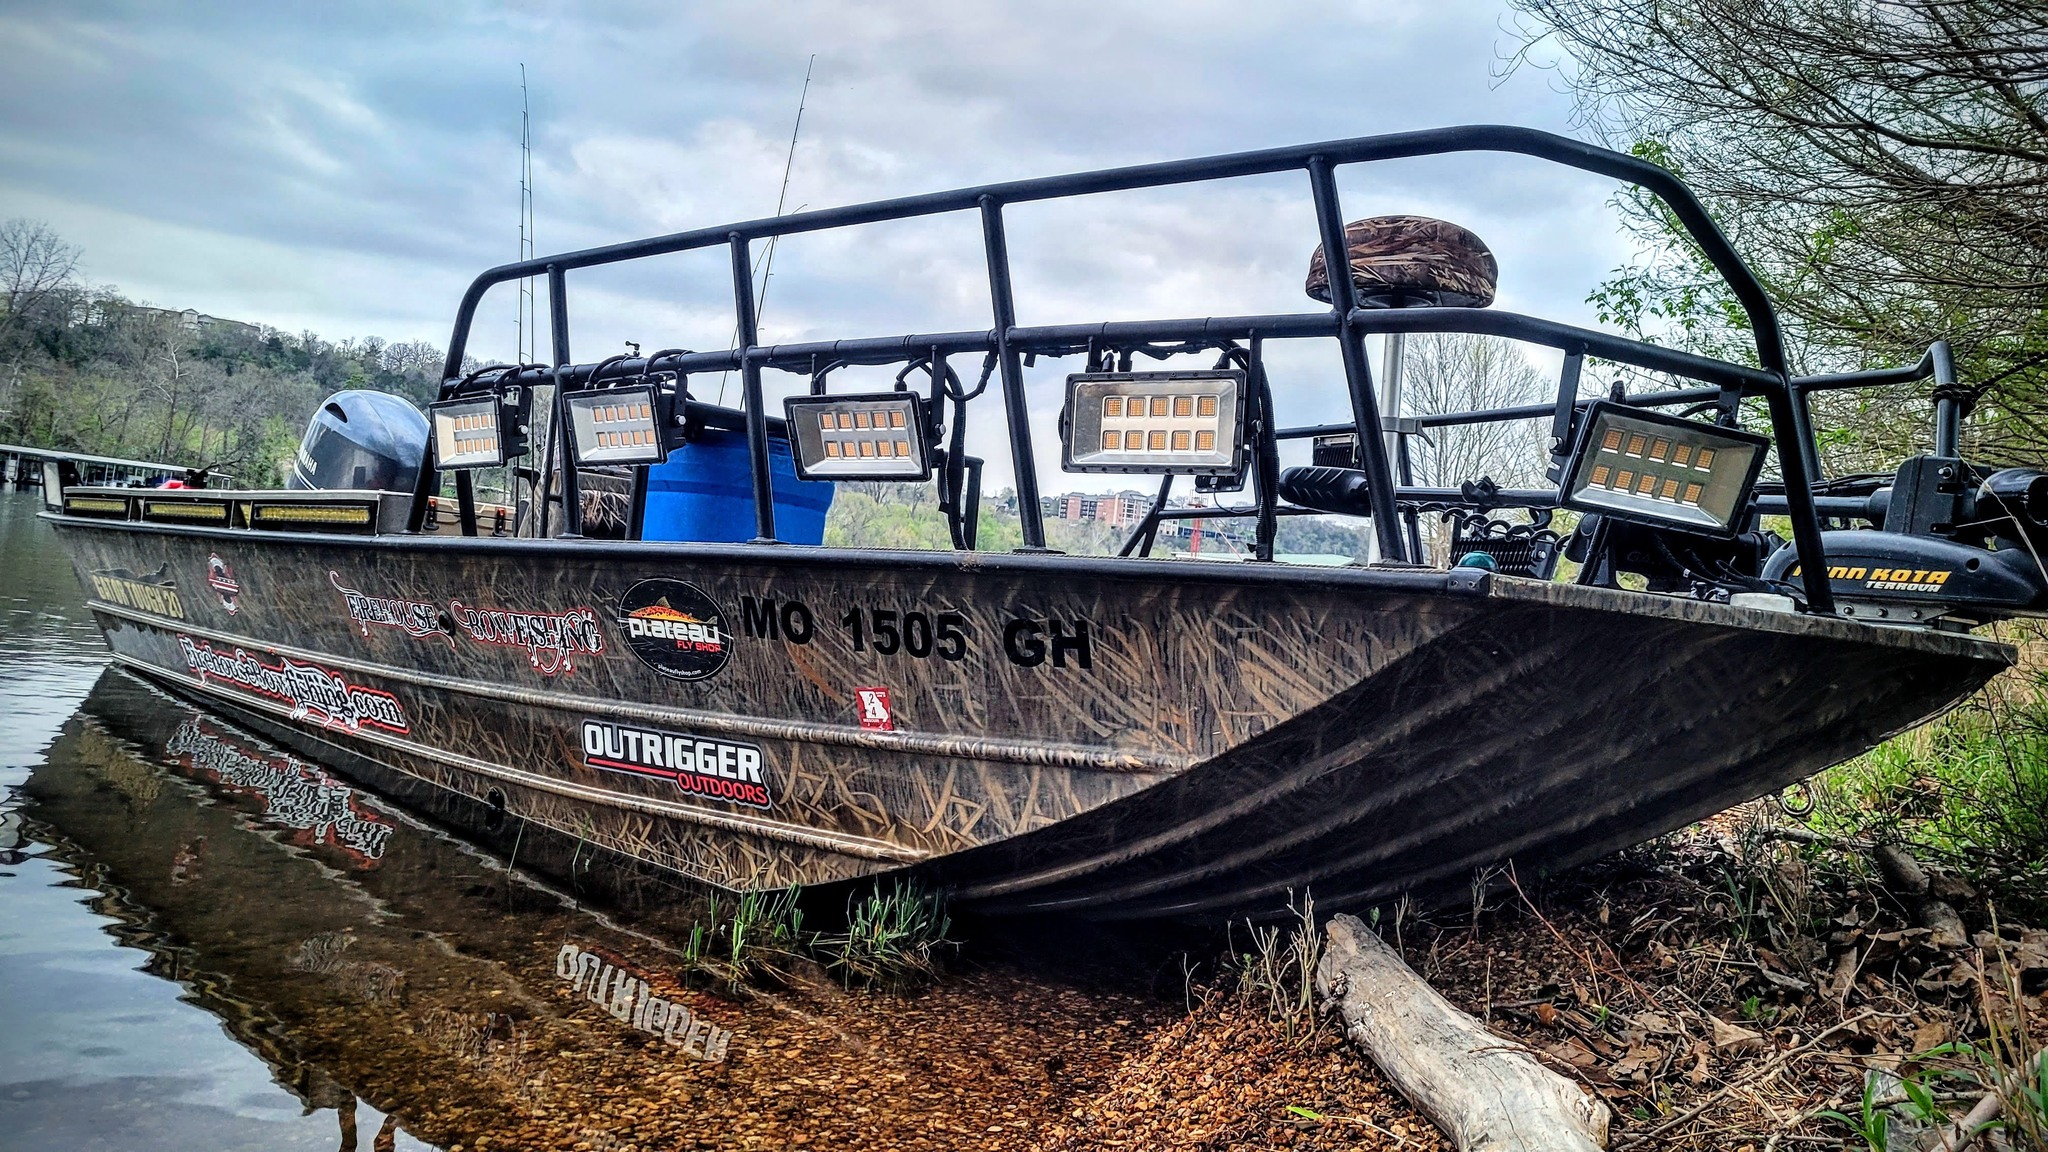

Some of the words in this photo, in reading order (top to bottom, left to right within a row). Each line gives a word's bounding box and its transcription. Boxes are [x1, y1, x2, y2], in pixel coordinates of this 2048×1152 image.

[1865, 580, 1942, 593] TERROVA
[1870, 567, 1952, 584] KOTA
[123, 581, 169, 616] TOUGH
[163, 590, 184, 620] 20
[677, 640, 693, 650] FLY
[695, 642, 721, 653] SHOP
[742, 596, 814, 645] MO
[843, 604, 967, 662] 1505
[1003, 618, 1093, 670] GH
[584, 724, 762, 784] OUTRIGGER
[677, 773, 768, 804] OUTDOORS
